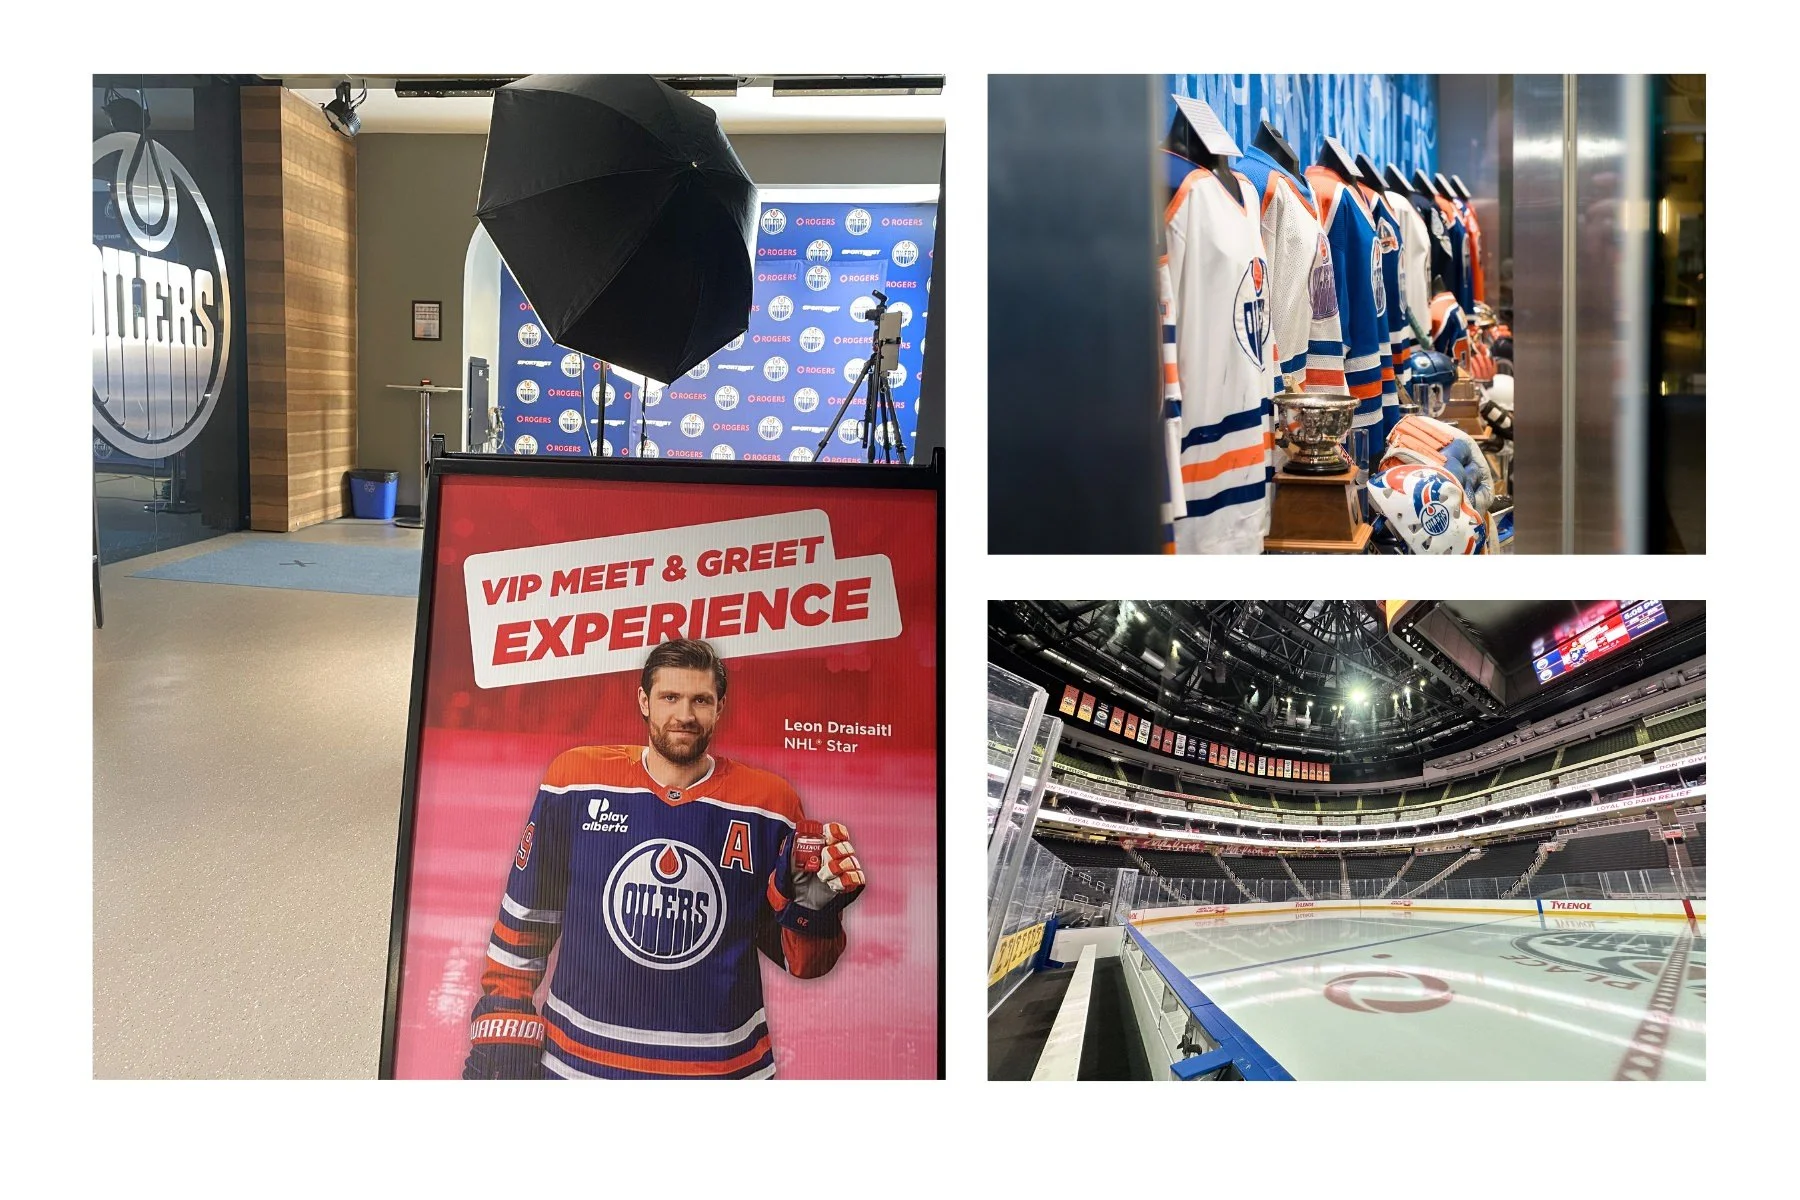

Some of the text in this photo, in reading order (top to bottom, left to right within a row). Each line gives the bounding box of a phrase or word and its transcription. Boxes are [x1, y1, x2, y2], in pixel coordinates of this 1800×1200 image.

[805, 218, 836, 226] ROGERS
[891, 218, 923, 226] ROGERS
[766, 274, 797, 282] ROGERS
[849, 273, 879, 282] ROGERS
[806, 366, 836, 374] ROGERS
[524, 416, 552, 424] ROGERS
[721, 424, 750, 432] ROGERS
[554, 445, 581, 453] ROGERS
[674, 450, 703, 458] ROGERS
[481, 535, 825, 606] VIP MEET & GREET
[491, 576, 872, 666] EXPERIENCE
[784, 718, 893, 737] Leon Draisaitl
[826, 738, 858, 754] Star
[1596, 802, 1622, 812] LOYAL
[1635, 796, 1657, 804] PAIN
[1658, 789, 1693, 801] RELIEF
[599, 812, 628, 824] play
[582, 822, 628, 833] alberta
[720, 820, 754, 874] A
[1550, 901, 1592, 910] TYLENOL
[622, 882, 709, 944] OILERS
[470, 1018, 544, 1040] WARRIOR
